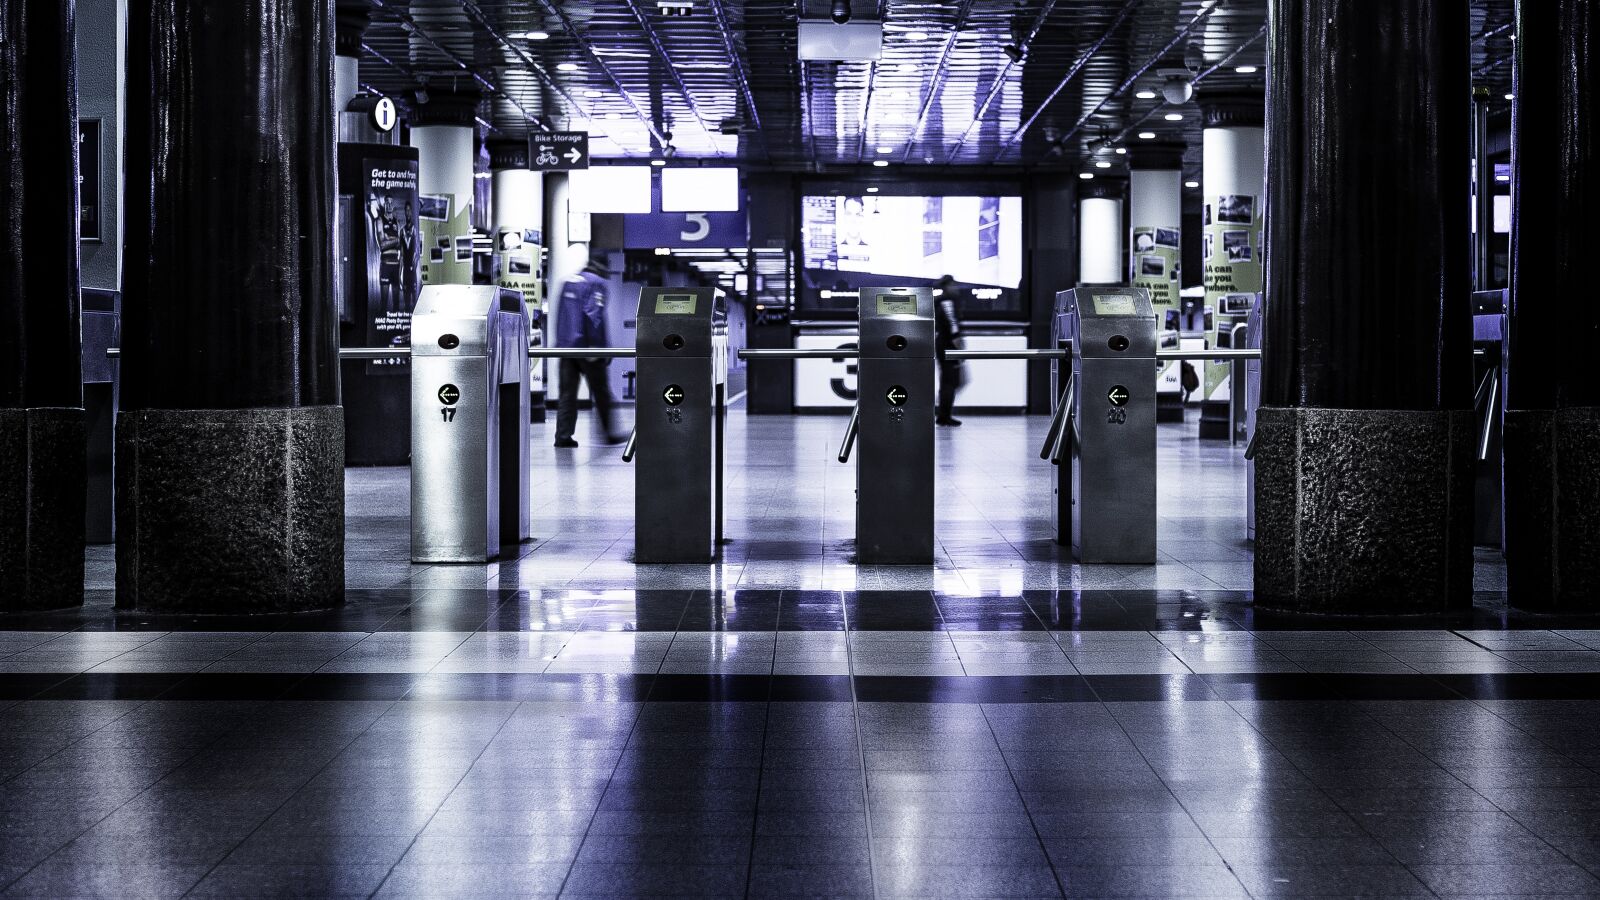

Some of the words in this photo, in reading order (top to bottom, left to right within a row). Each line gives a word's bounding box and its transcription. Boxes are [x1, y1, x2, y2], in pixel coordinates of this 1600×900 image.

[535, 134, 551, 142] Bike
[552, 134, 582, 143] Storage
[371, 169, 386, 178] Get
[388, 170, 396, 178] to
[371, 179, 385, 187] the
[386, 180, 403, 189] game
[1214, 265, 1232, 273] can
[1214, 275, 1232, 284] you
[1153, 291, 1169, 299] you
[441, 407, 456, 422] 17
[1108, 407, 1127, 425] 20
